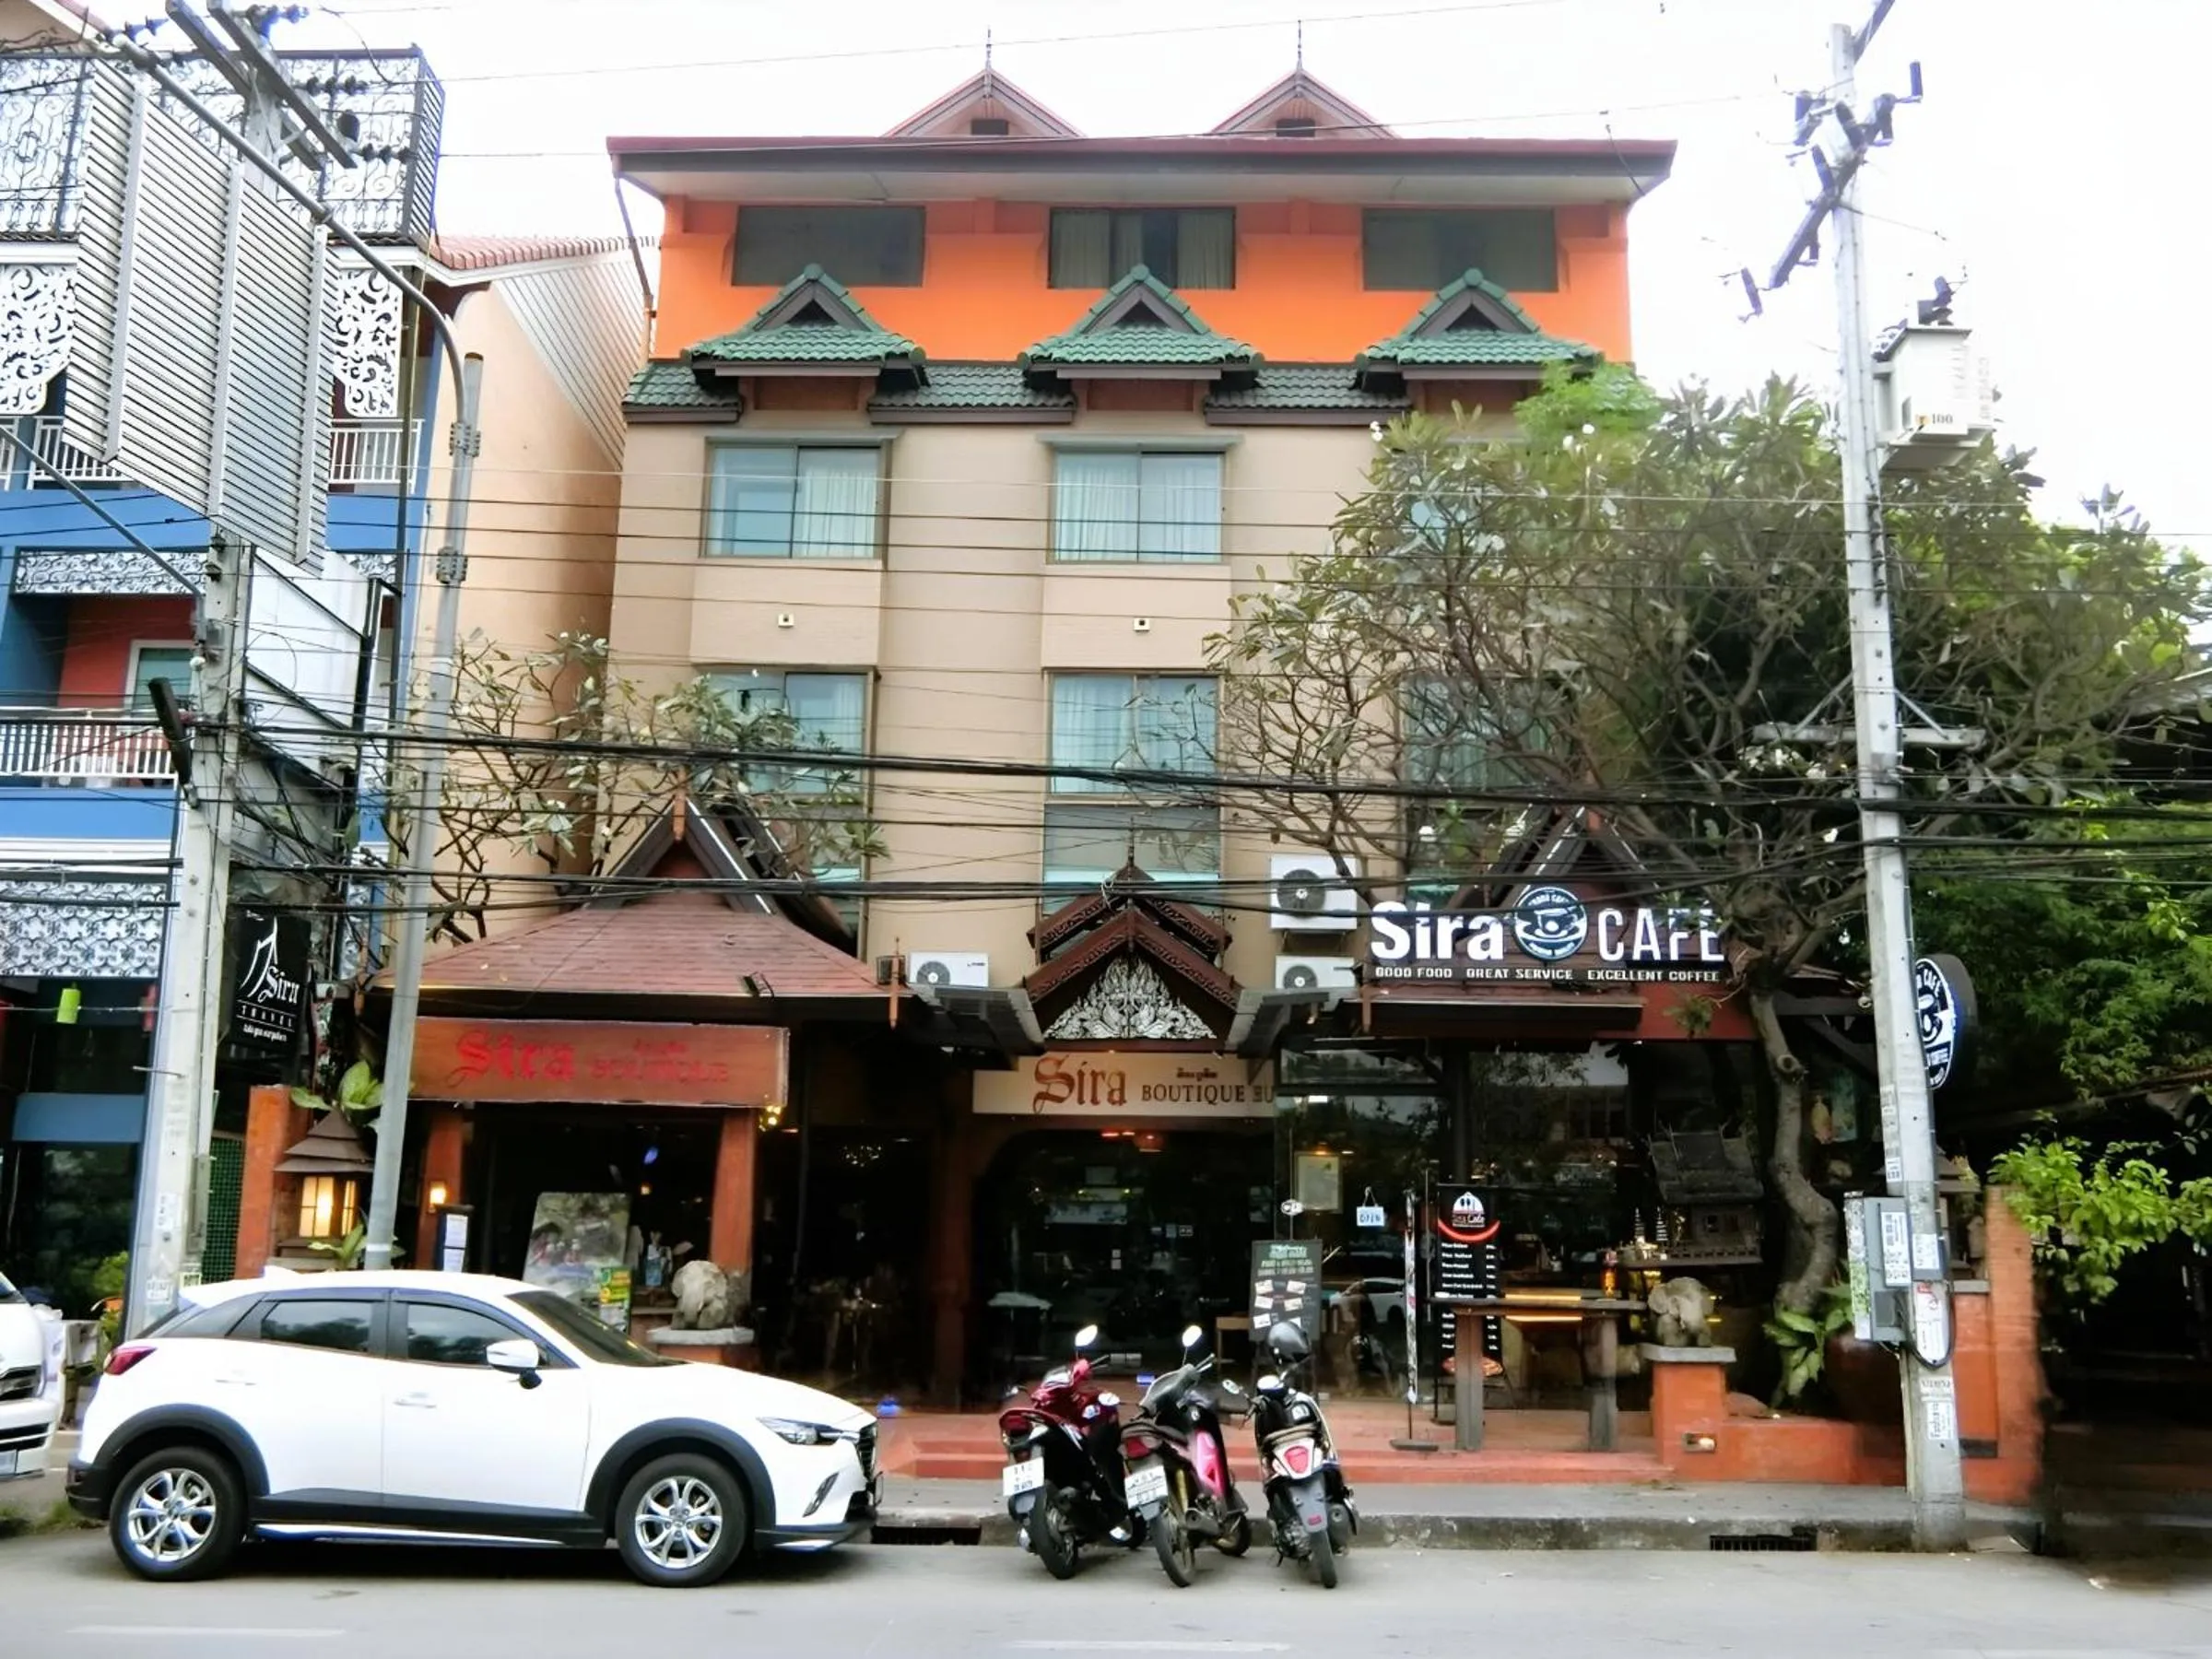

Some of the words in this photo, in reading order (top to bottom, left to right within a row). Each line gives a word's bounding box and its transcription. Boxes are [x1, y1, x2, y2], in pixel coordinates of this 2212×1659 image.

[1370, 900, 1504, 961] Sira
[257, 965, 300, 1004] Sira
[1375, 967, 1412, 978] GOOD
[1417, 967, 1453, 979] FOOD
[1466, 968, 1509, 979] GREAT
[1515, 968, 1573, 980] SERVICE
[1587, 969, 1663, 981] EXCELLENT
[1668, 970, 1720, 982] COFFEE
[241, 1005, 292, 1028] TRAVEL
[447, 1025, 578, 1087] Sira
[1032, 1054, 1127, 1114] Sira
[1142, 1083, 1245, 1105] BOUTIQUE
